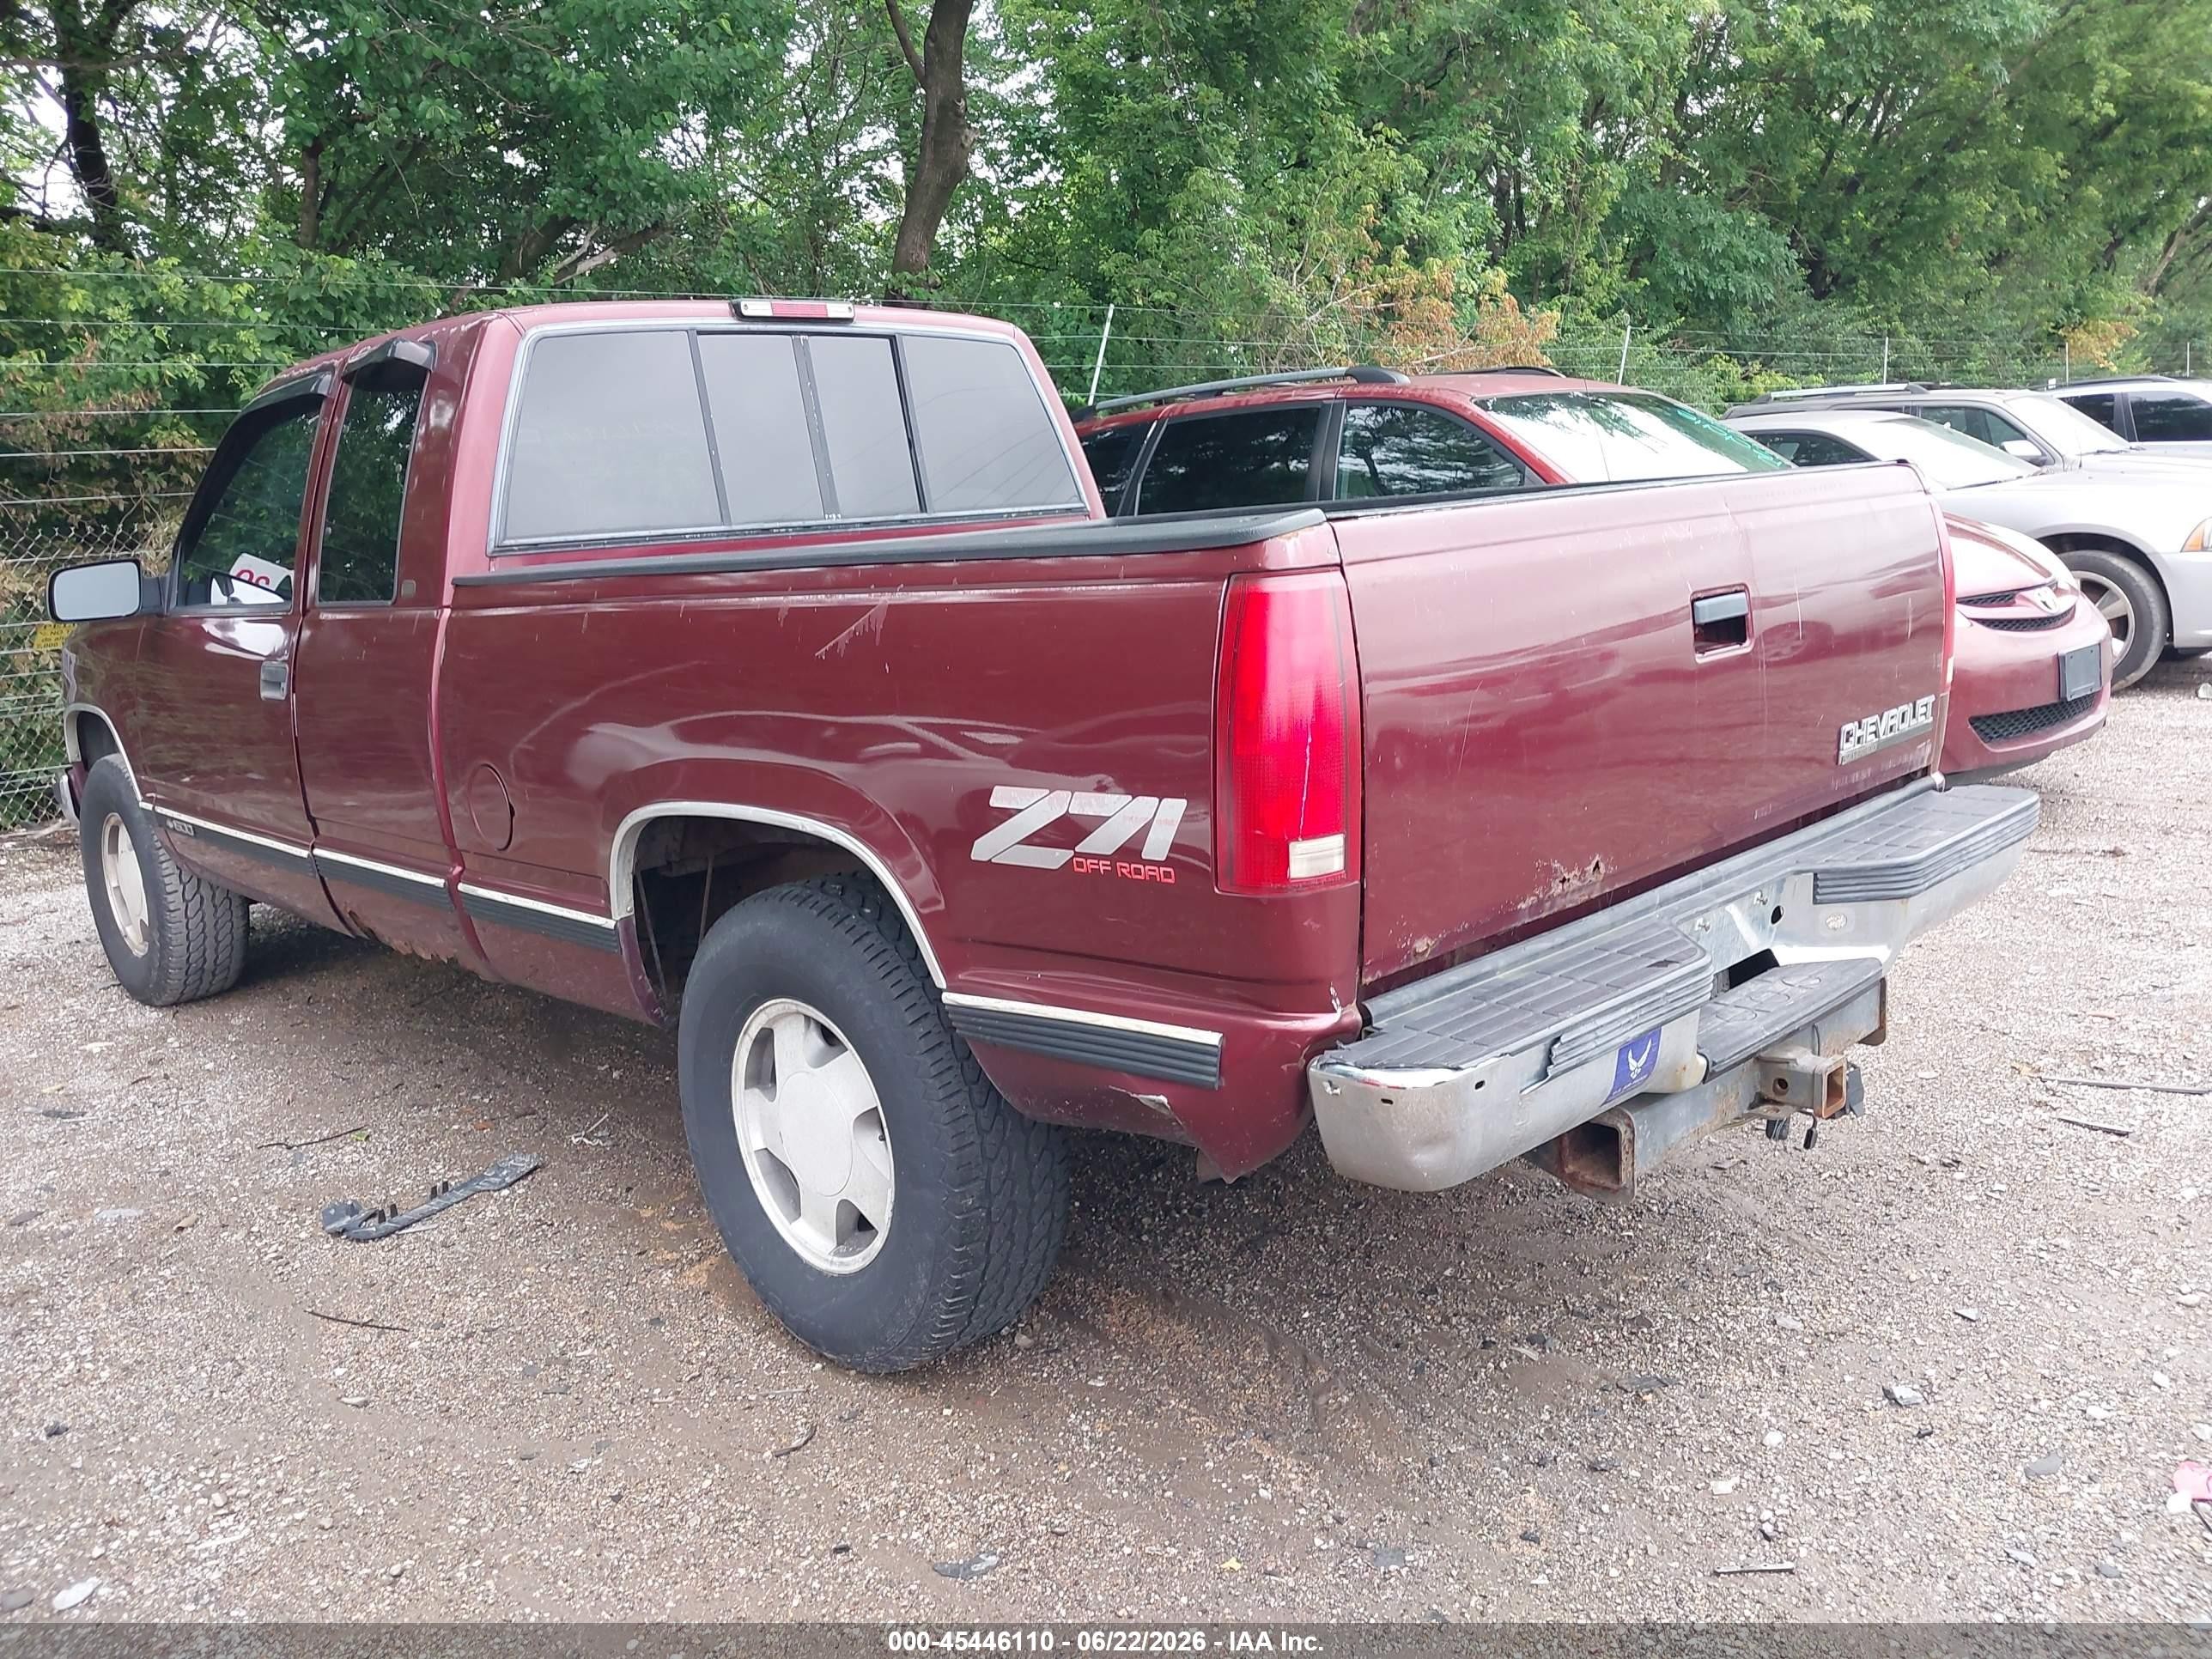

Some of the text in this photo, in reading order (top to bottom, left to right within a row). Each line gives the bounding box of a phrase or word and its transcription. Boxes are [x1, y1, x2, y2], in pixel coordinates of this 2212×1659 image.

[1839, 694, 1936, 752] CHEVROLET
[969, 785, 1188, 870] Z71
[1073, 857, 1176, 884] OFF ROAD
